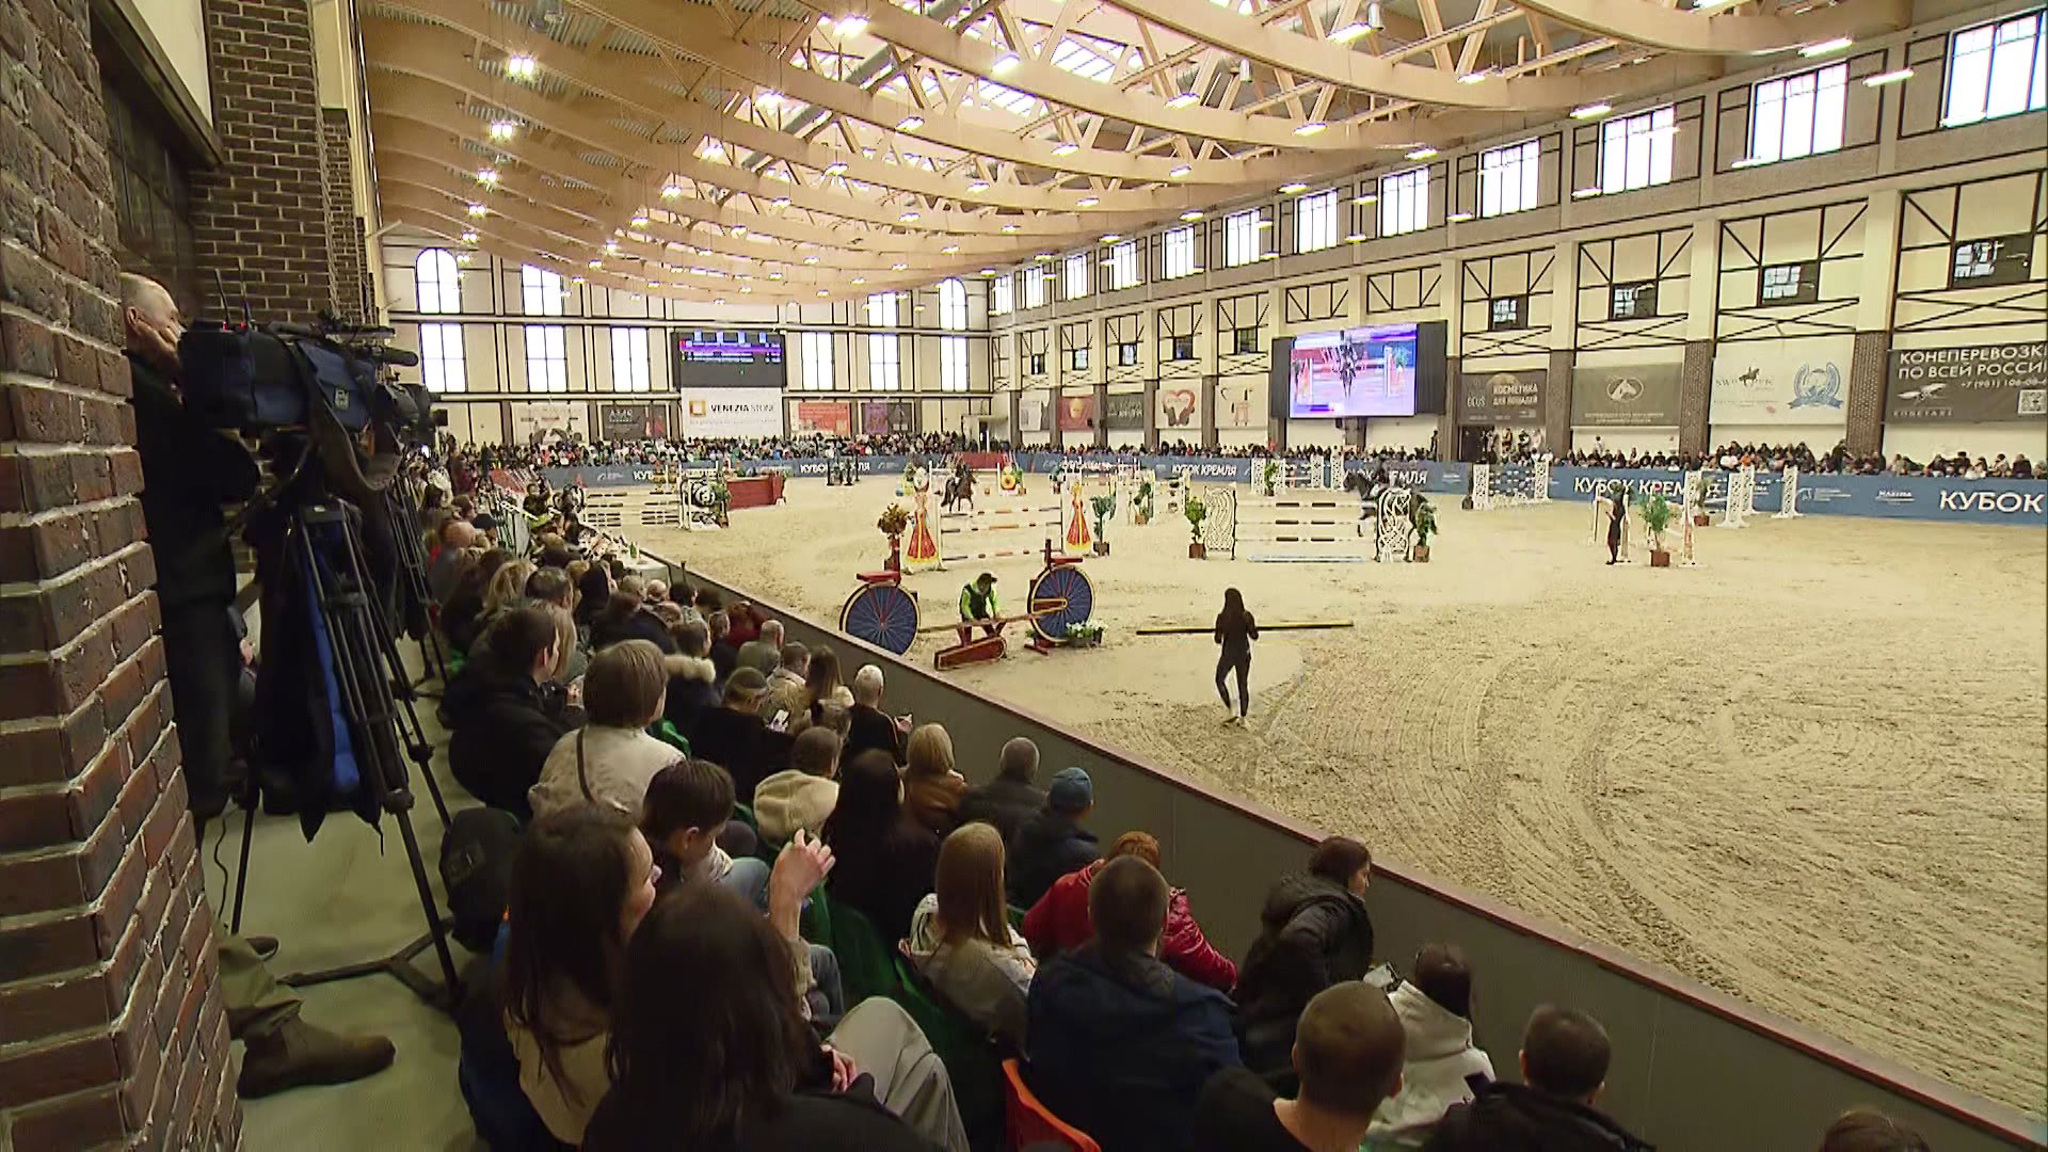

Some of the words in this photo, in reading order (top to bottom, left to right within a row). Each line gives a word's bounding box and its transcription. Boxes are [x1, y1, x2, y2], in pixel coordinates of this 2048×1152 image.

[1898, 366, 1924, 380] ПО
[1928, 362, 1972, 378] ВСЕЙ
[1493, 383, 1538, 395] КОСМЕТИКА
[711, 404, 749, 413] VENEZIA
[1939, 489, 2045, 513] КУБОК
